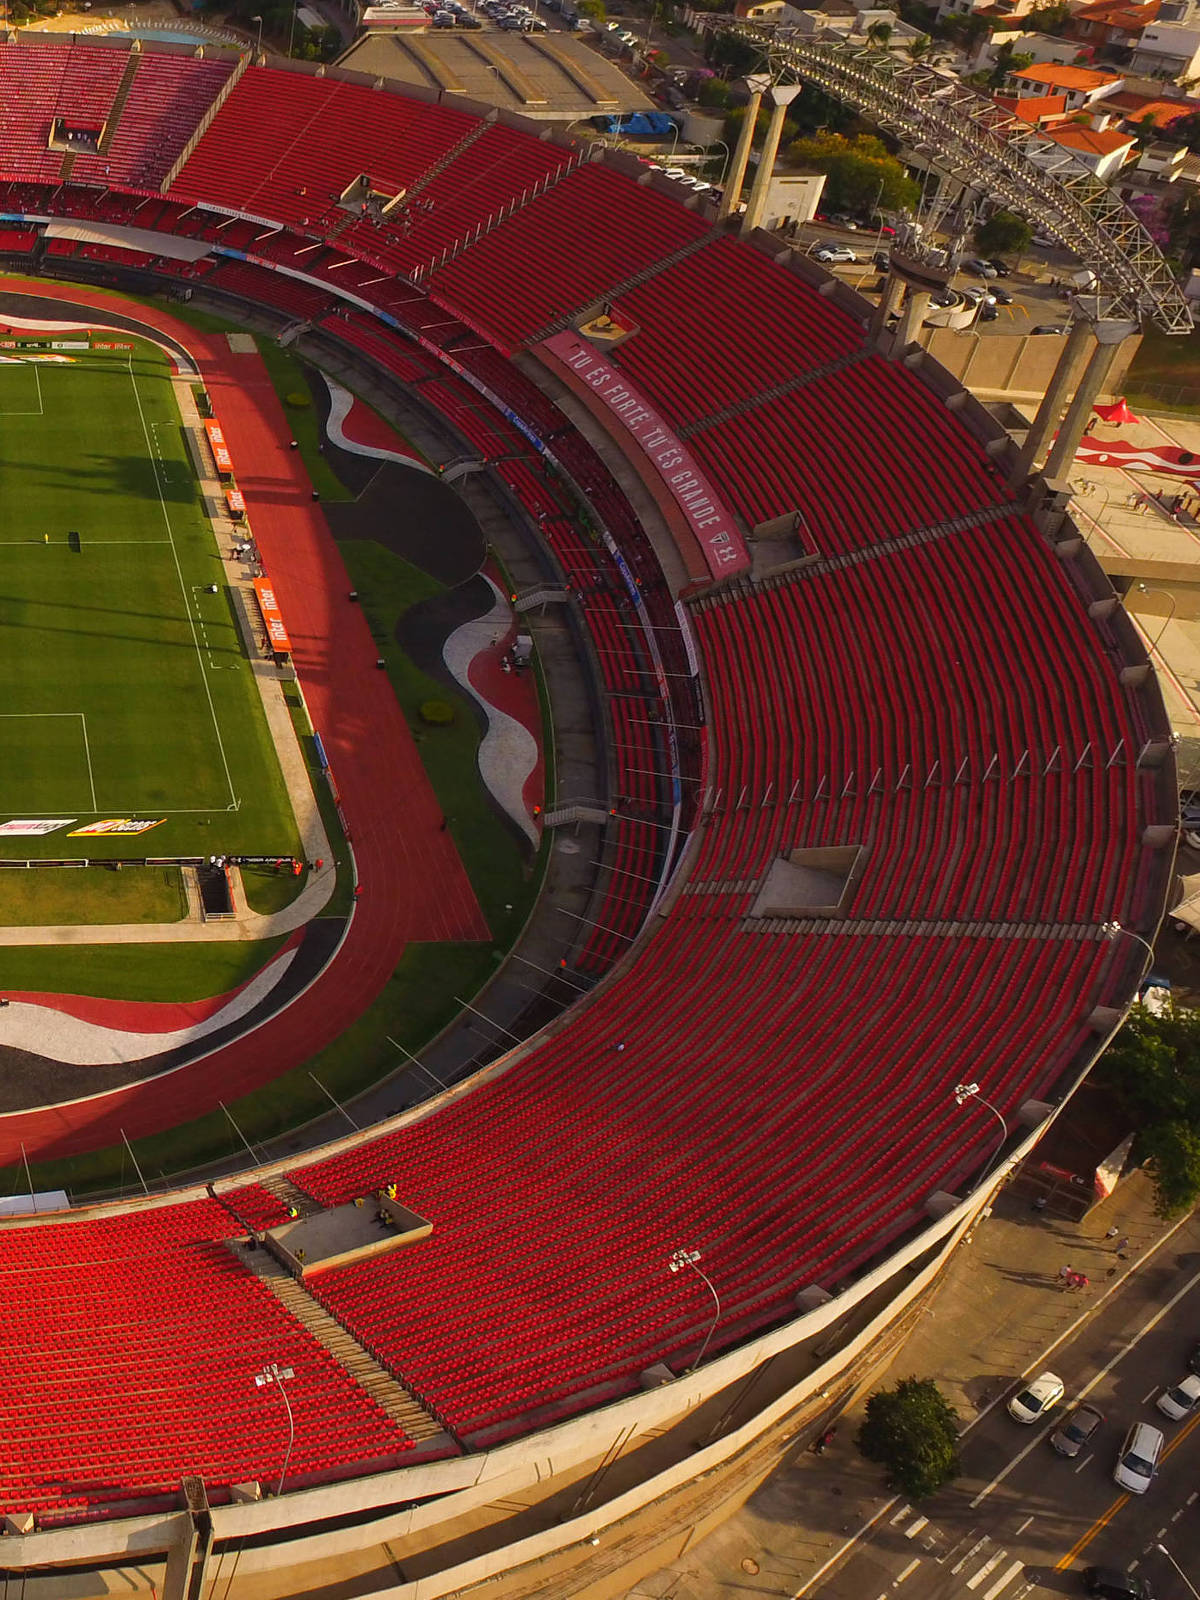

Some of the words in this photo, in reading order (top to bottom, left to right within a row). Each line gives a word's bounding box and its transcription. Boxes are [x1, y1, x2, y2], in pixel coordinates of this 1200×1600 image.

[568, 350, 593, 369] TU
[585, 366, 610, 387] ÉS
[603, 384, 650, 430] FORTE,
[642, 427, 668, 448] TU
[657, 447, 682, 469] ÉS
[671, 470, 721, 528] GRANDE
[260, 589, 279, 610] inter
[270, 618, 288, 640] inter
